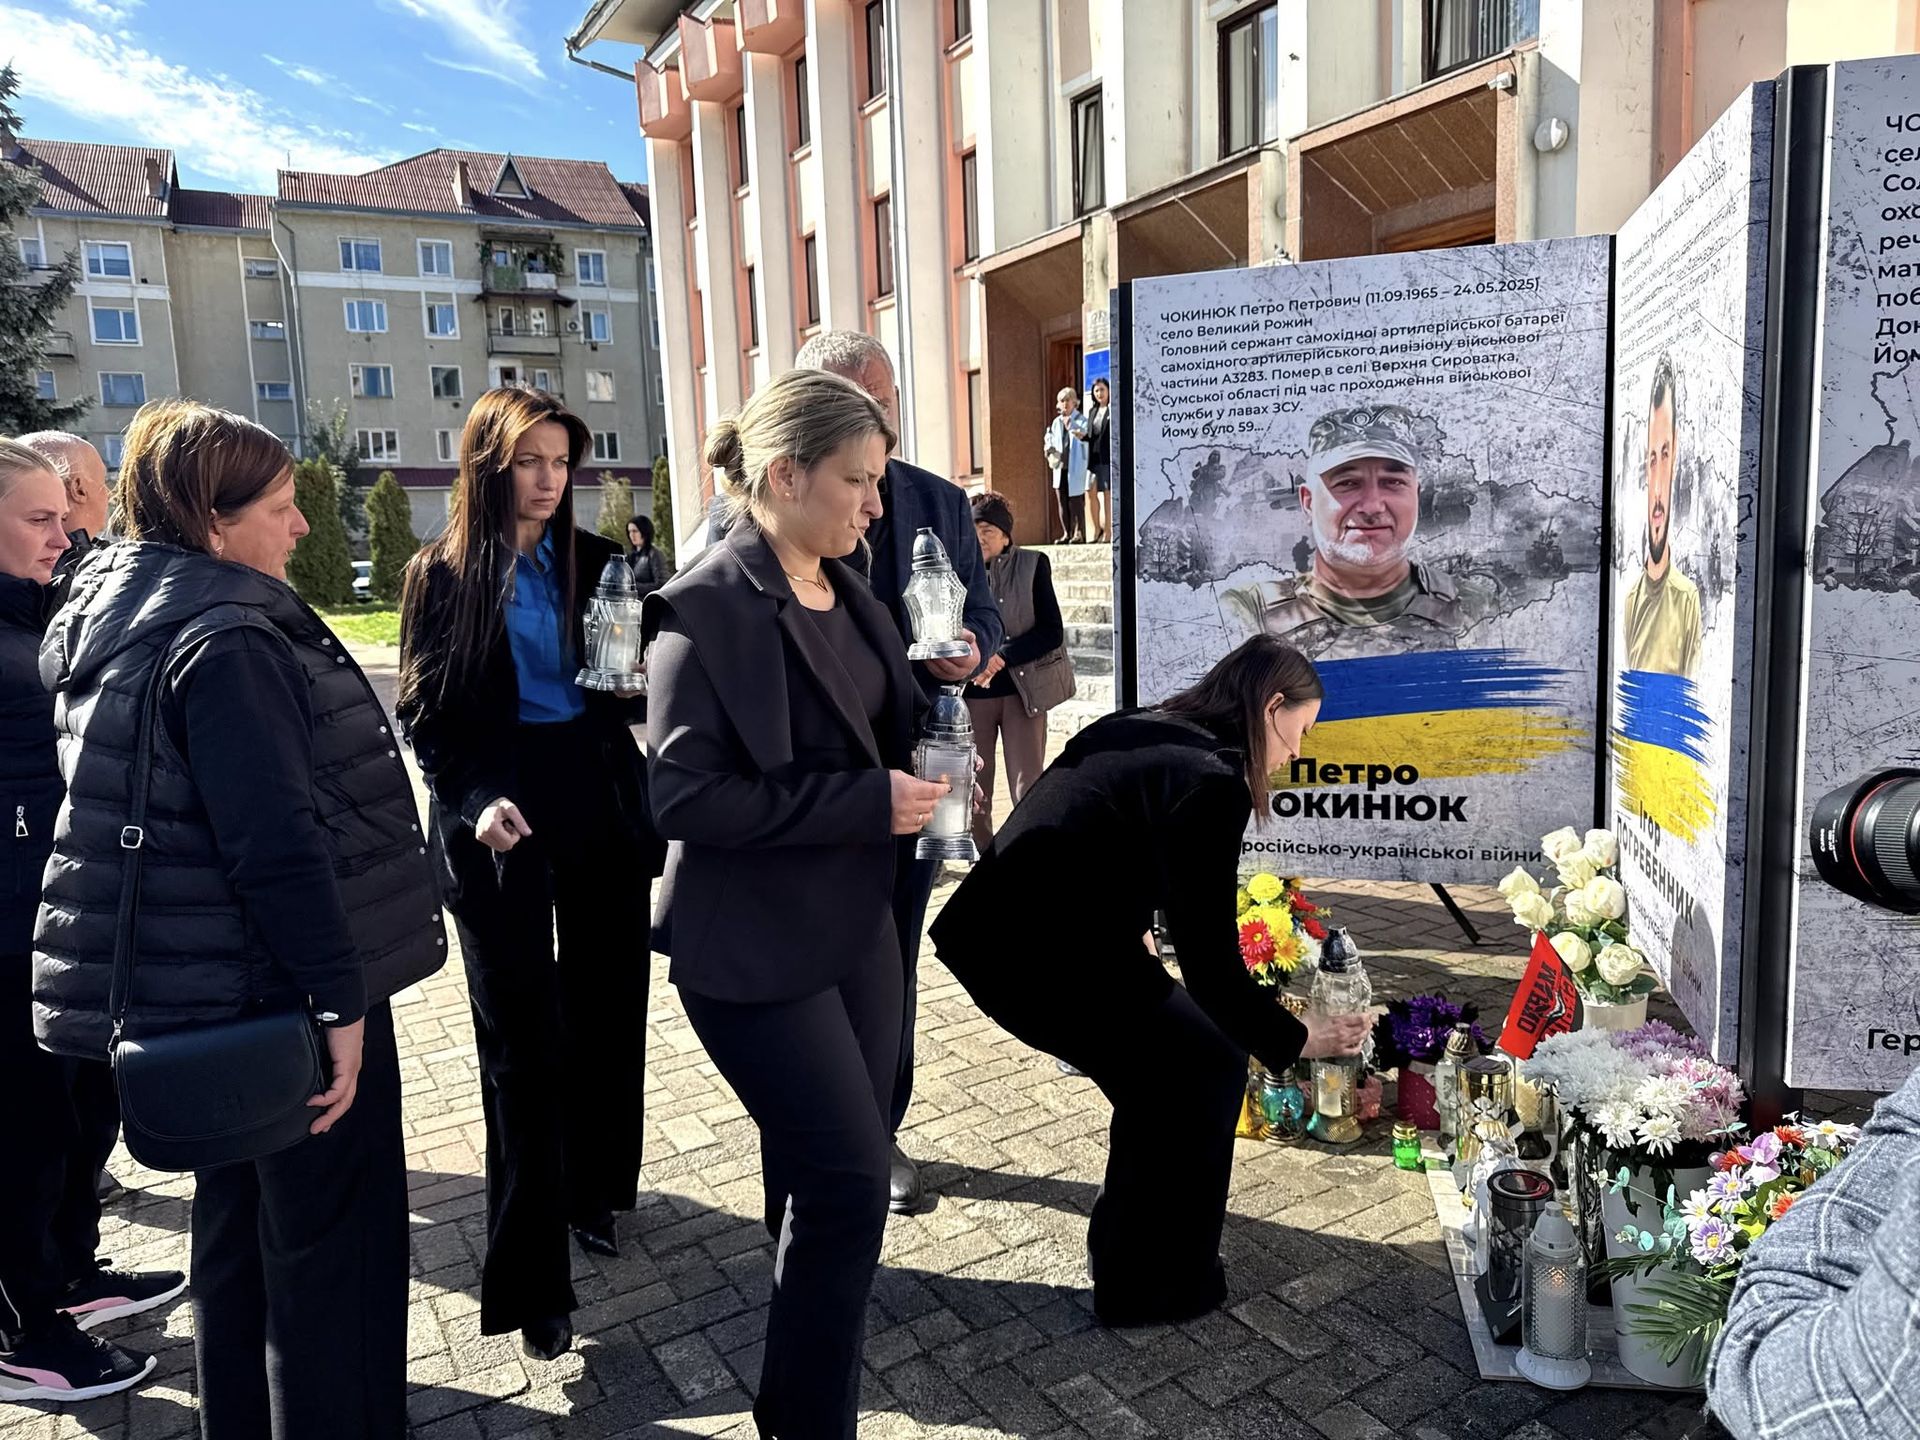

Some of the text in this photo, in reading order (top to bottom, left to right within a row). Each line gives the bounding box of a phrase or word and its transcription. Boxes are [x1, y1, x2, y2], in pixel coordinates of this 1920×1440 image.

[1160, 306, 1236, 323] ЧОКИНЮК
[1240, 303, 1284, 316] Петро
[1289, 296, 1361, 311] Петрович
[1365, 286, 1438, 306] (11.09.1965
[1453, 276, 1540, 296] 24.05.2025)
[1160, 318, 1313, 340] село Великий Рожин
[1161, 310, 1564, 356] Головний сержант самохідної артилерійської батареї
[1161, 329, 1540, 373] самохідного артилерійського дивізіону військової
[1161, 352, 1519, 389] частини А3283. Помер в селі Верхня Сироватка,
[1161, 366, 1531, 407] Сумської області під час проходження військової
[1161, 401, 1304, 423] служби у лавах ЗСУ.
[1161, 424, 1199, 438] Йому
[1202, 420, 1235, 437] було
[1290, 758, 1419, 792] Петро
[1264, 791, 1468, 823] ОКИНЮК
[1241, 838, 1542, 862] російсько-української війни
